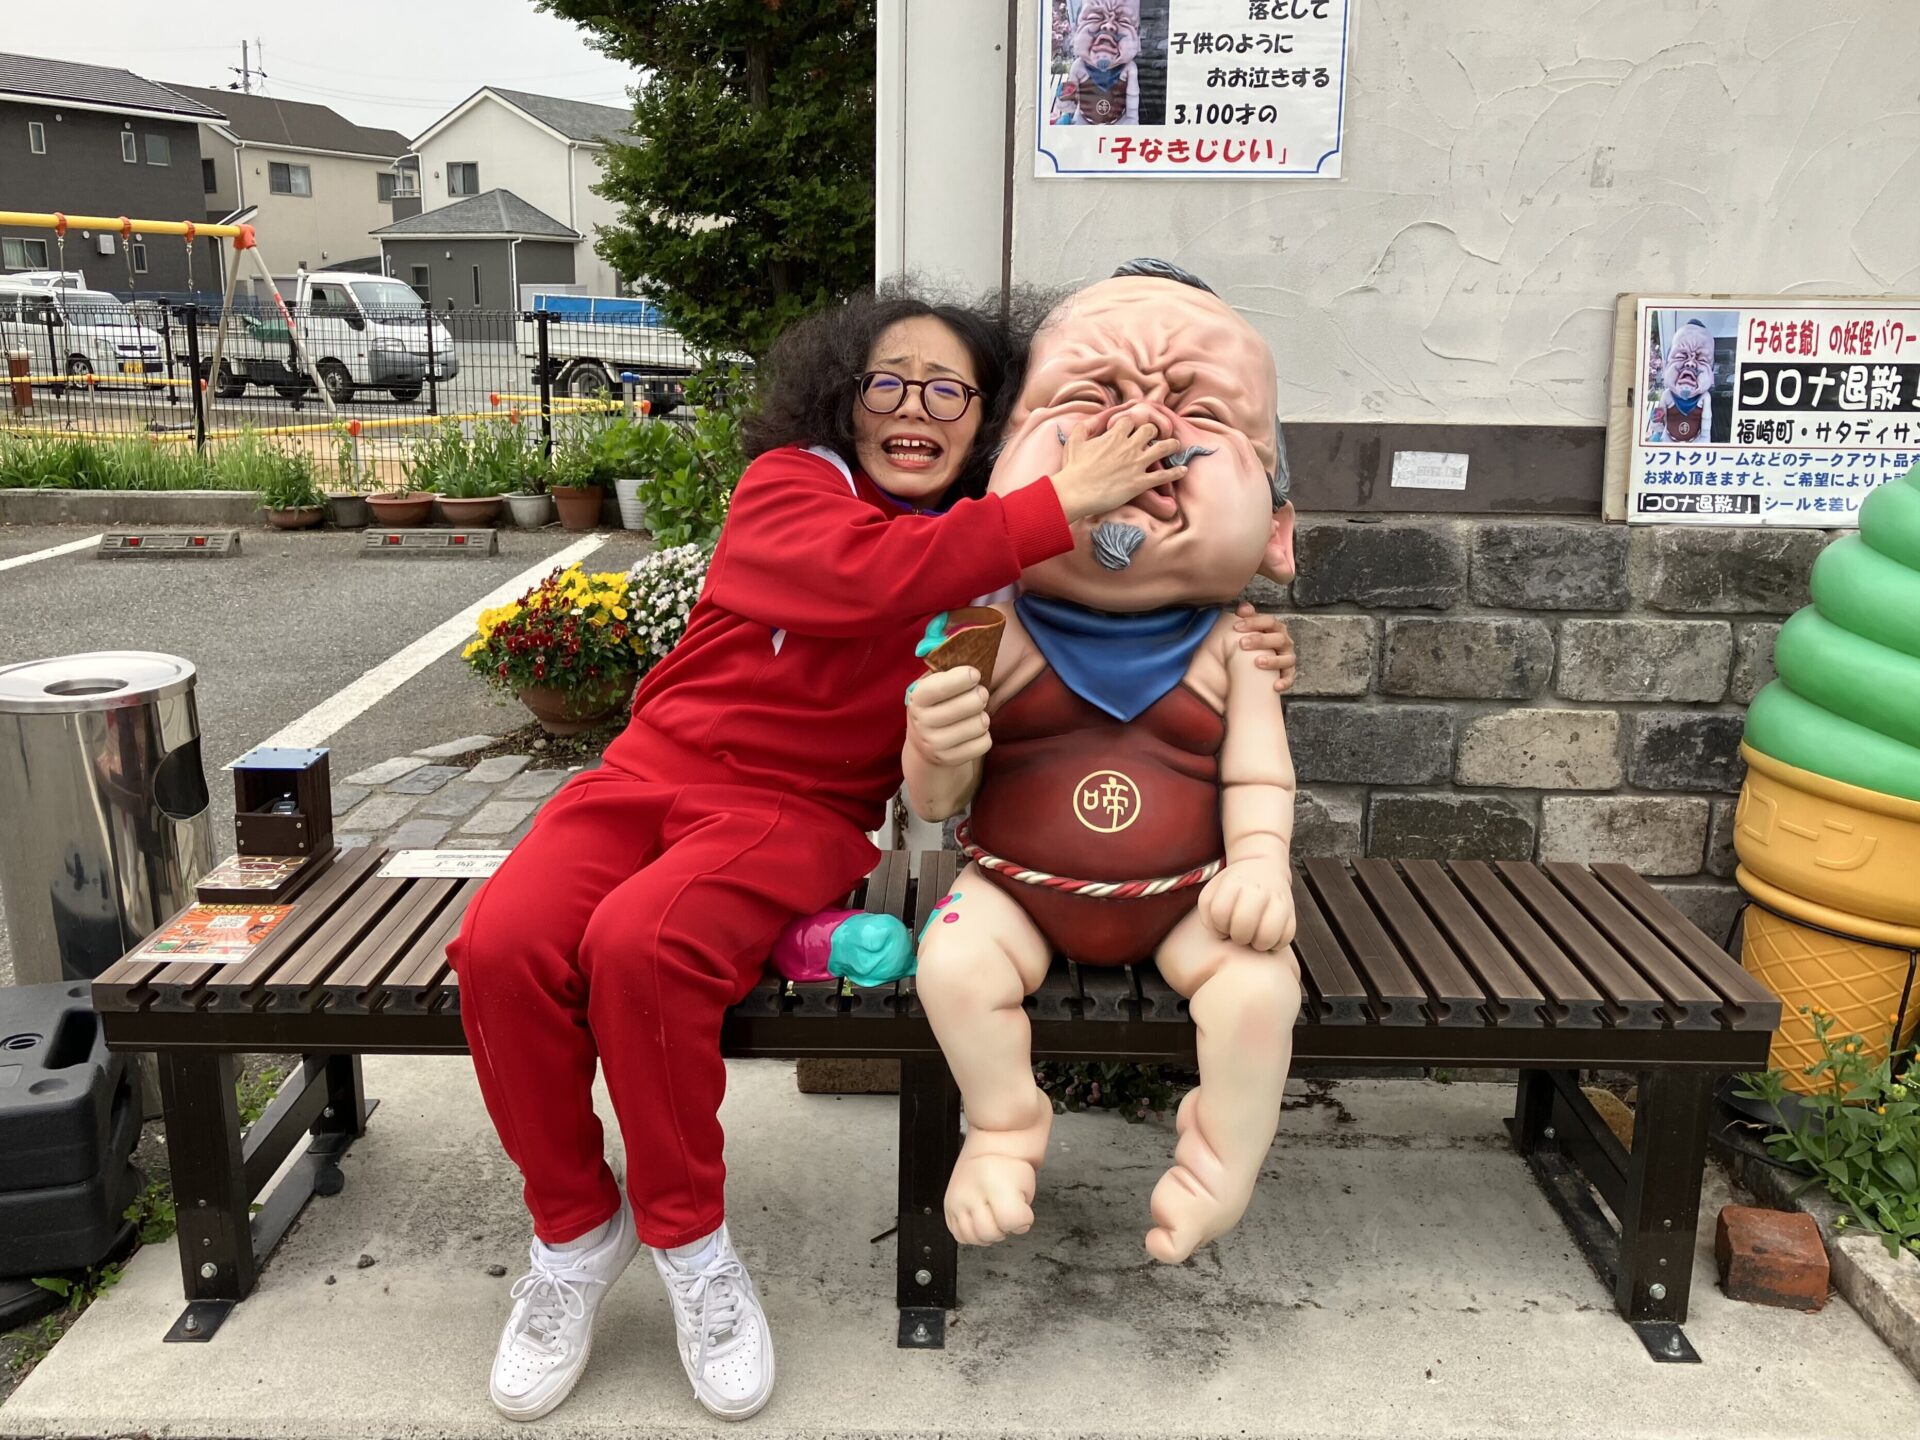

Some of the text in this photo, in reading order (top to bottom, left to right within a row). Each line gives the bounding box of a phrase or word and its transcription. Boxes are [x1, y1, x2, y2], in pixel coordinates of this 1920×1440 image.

[1248, 0, 1330, 20] 落として
[1170, 32, 1294, 55] 子供のように
[1206, 67, 1331, 88] おお泣きする
[1098, 136, 1287, 165] 「子なきじじい」
